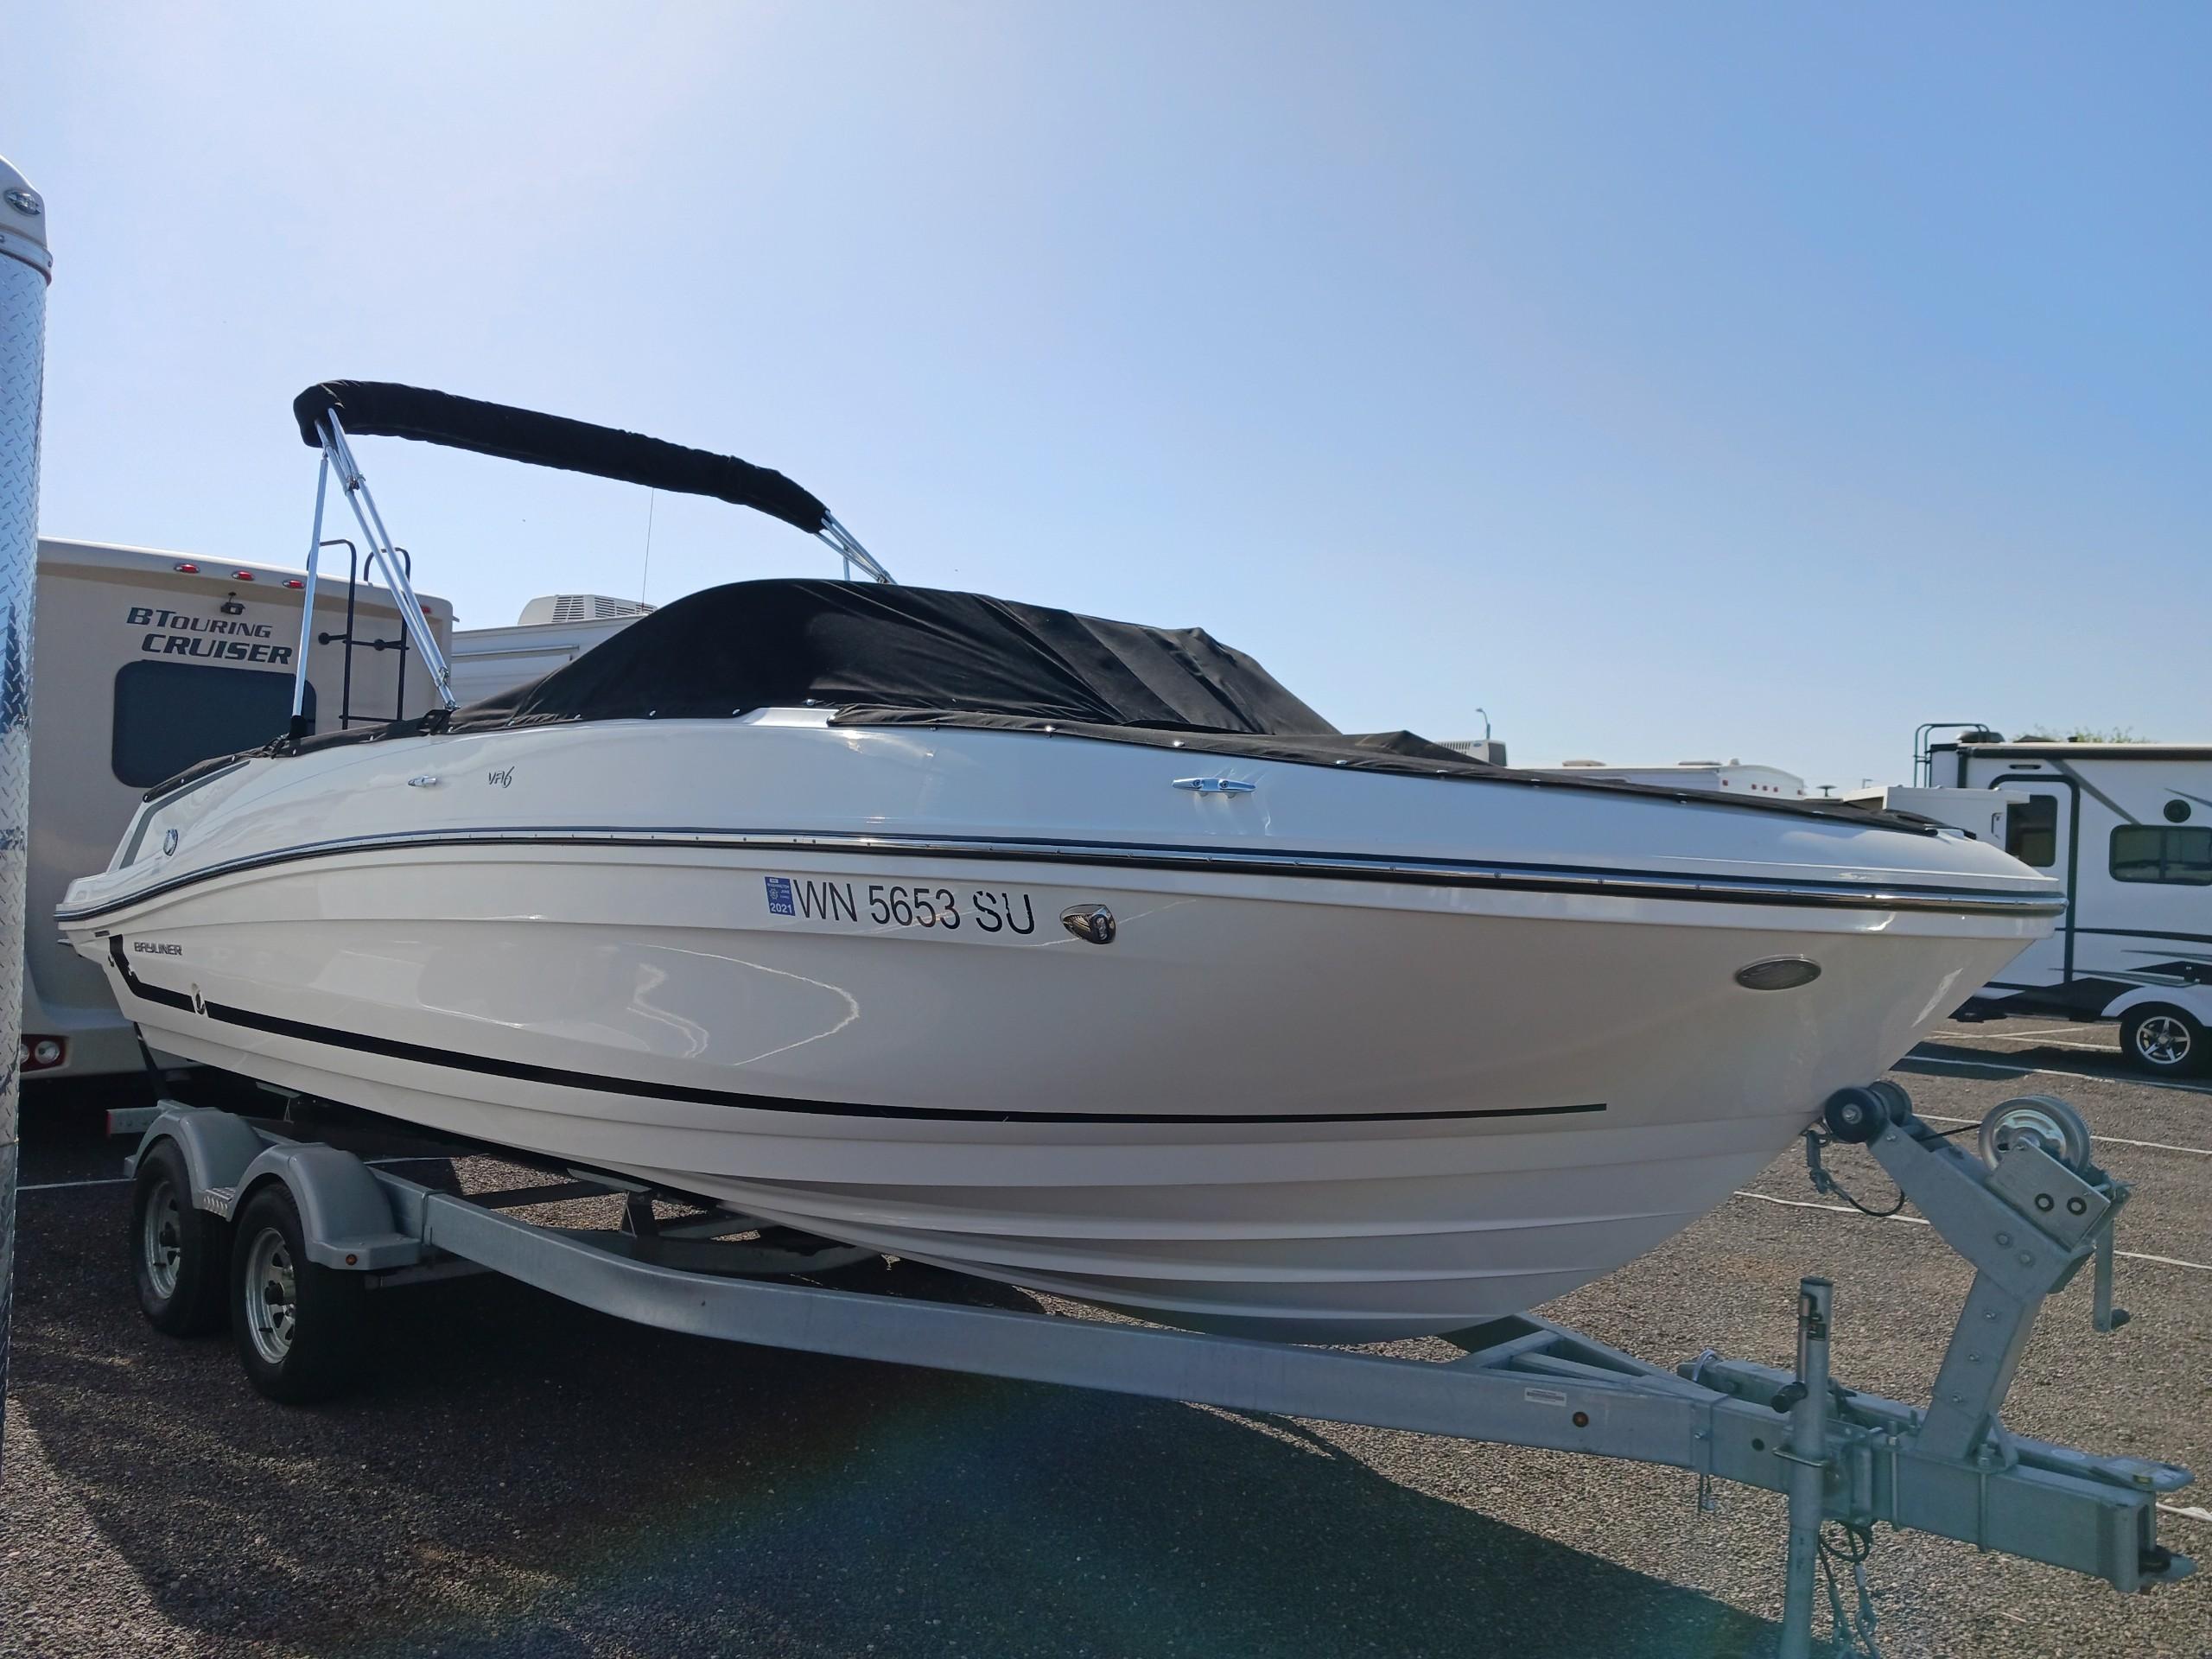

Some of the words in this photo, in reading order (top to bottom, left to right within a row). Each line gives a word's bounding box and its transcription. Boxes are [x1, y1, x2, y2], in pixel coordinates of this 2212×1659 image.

[142, 633, 293, 664] CRUISER
[770, 902, 793, 914] 2021
[793, 879, 858, 922] WN
[868, 885, 961, 930] 5653
[973, 891, 1036, 935] SU
[134, 942, 182, 956] BAYLINER
